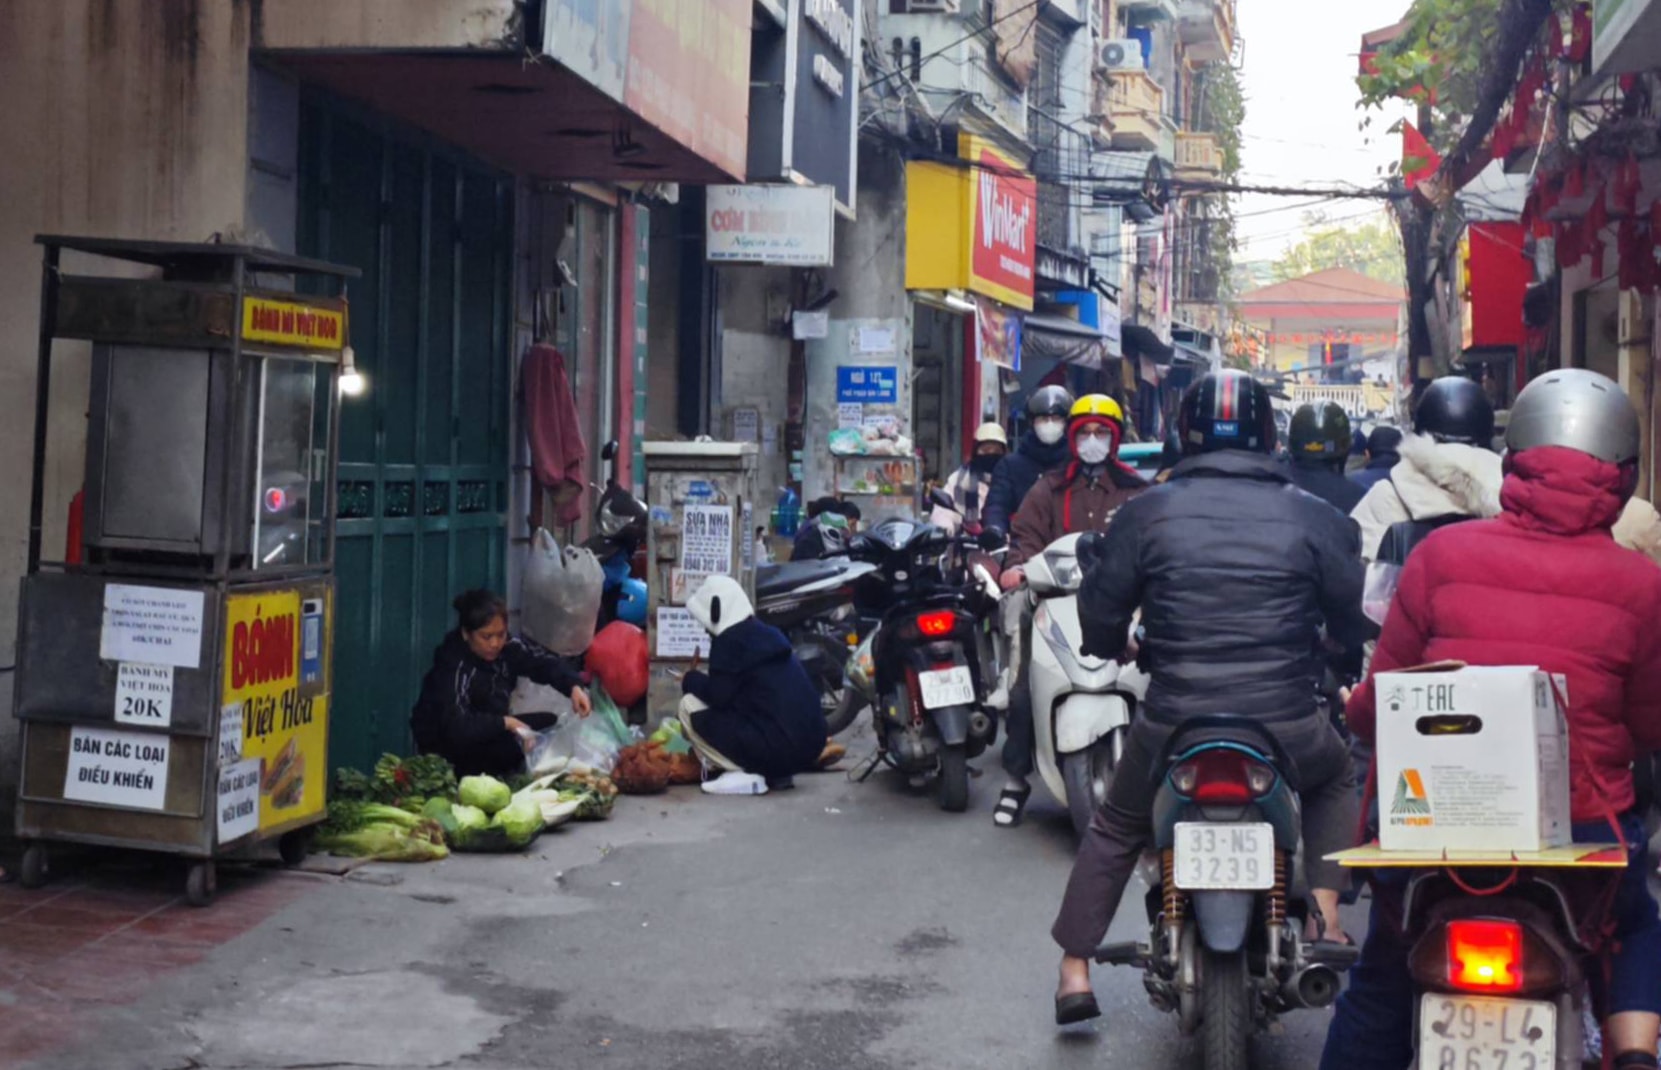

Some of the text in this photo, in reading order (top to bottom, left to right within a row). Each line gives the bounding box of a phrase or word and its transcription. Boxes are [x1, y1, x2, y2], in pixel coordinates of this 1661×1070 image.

[122, 696, 163, 718] 20K
[1427, 684, 1456, 711] EAC
[73, 735, 165, 765] BÁN CÁC LOẠI
[1190, 857, 1259, 882] 3239
